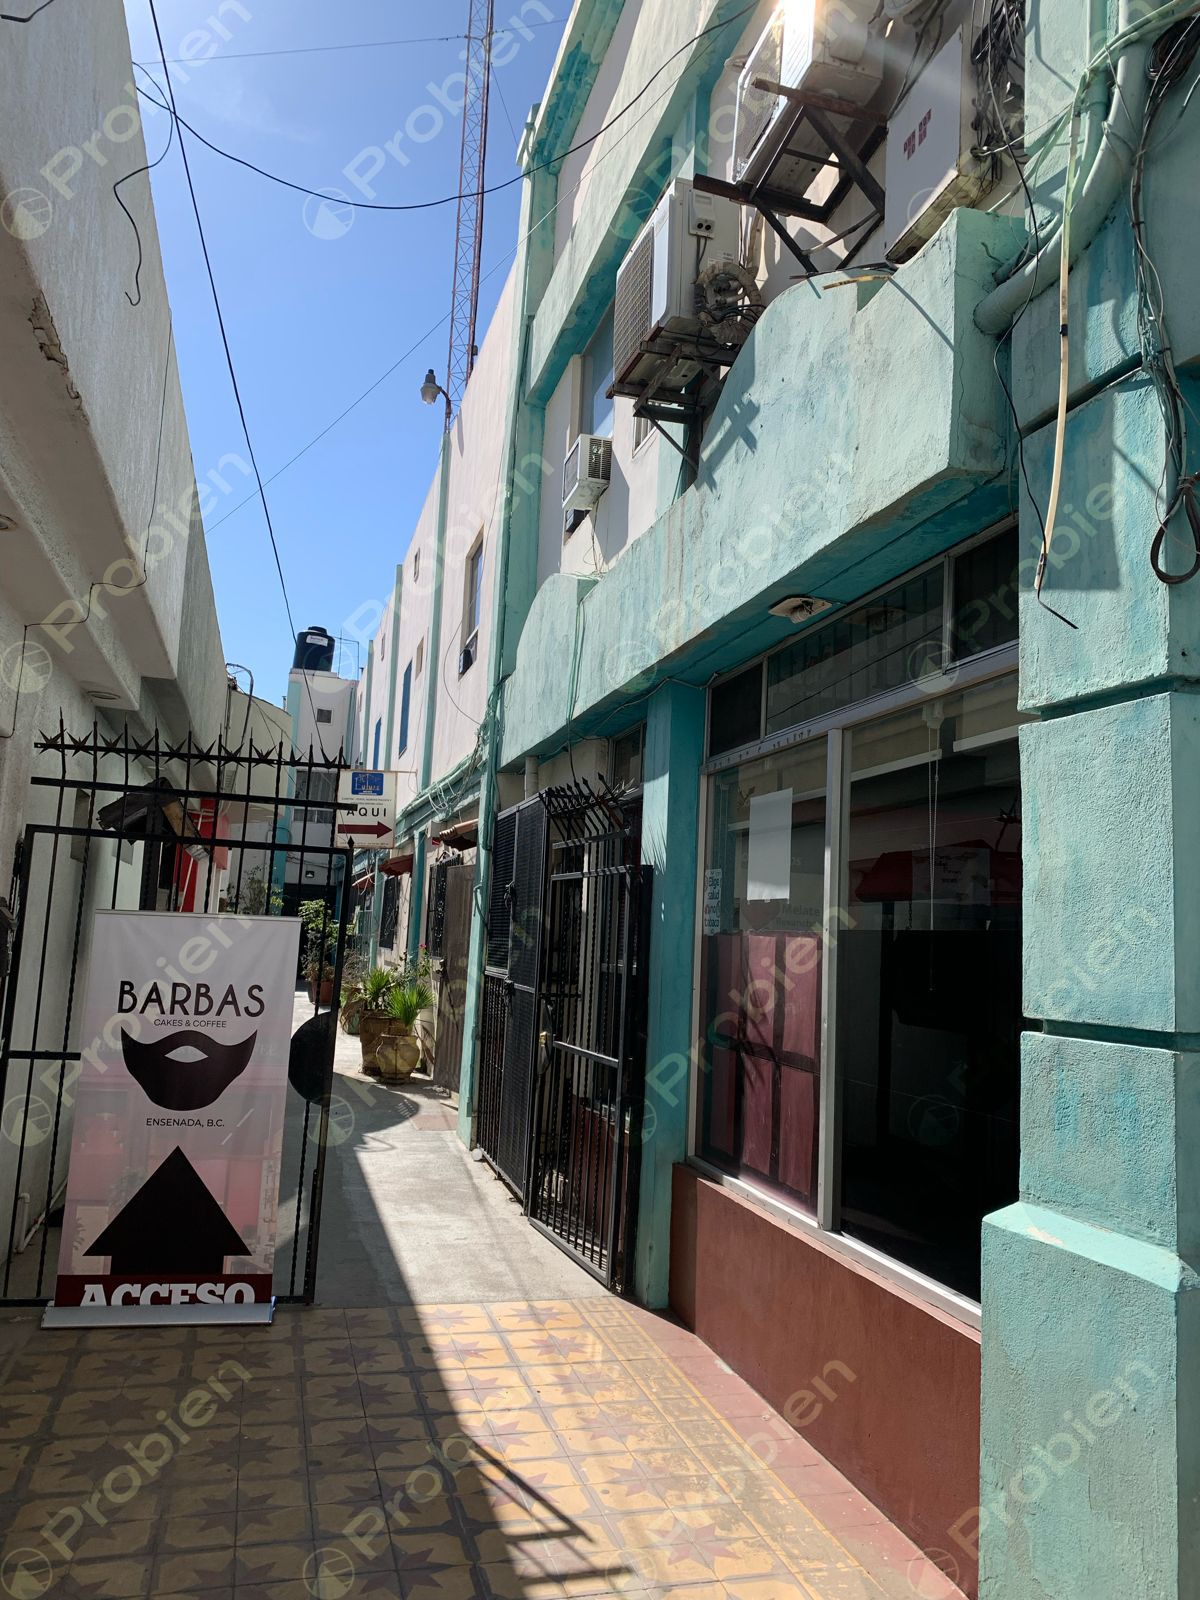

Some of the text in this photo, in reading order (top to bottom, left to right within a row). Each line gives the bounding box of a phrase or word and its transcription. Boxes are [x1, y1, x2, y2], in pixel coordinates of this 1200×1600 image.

[117, 980, 265, 1018] BARBAS
[153, 1018, 227, 1028] CAKES & COFFEE
[145, 1117, 225, 1128] ENSENADA, B.C.
